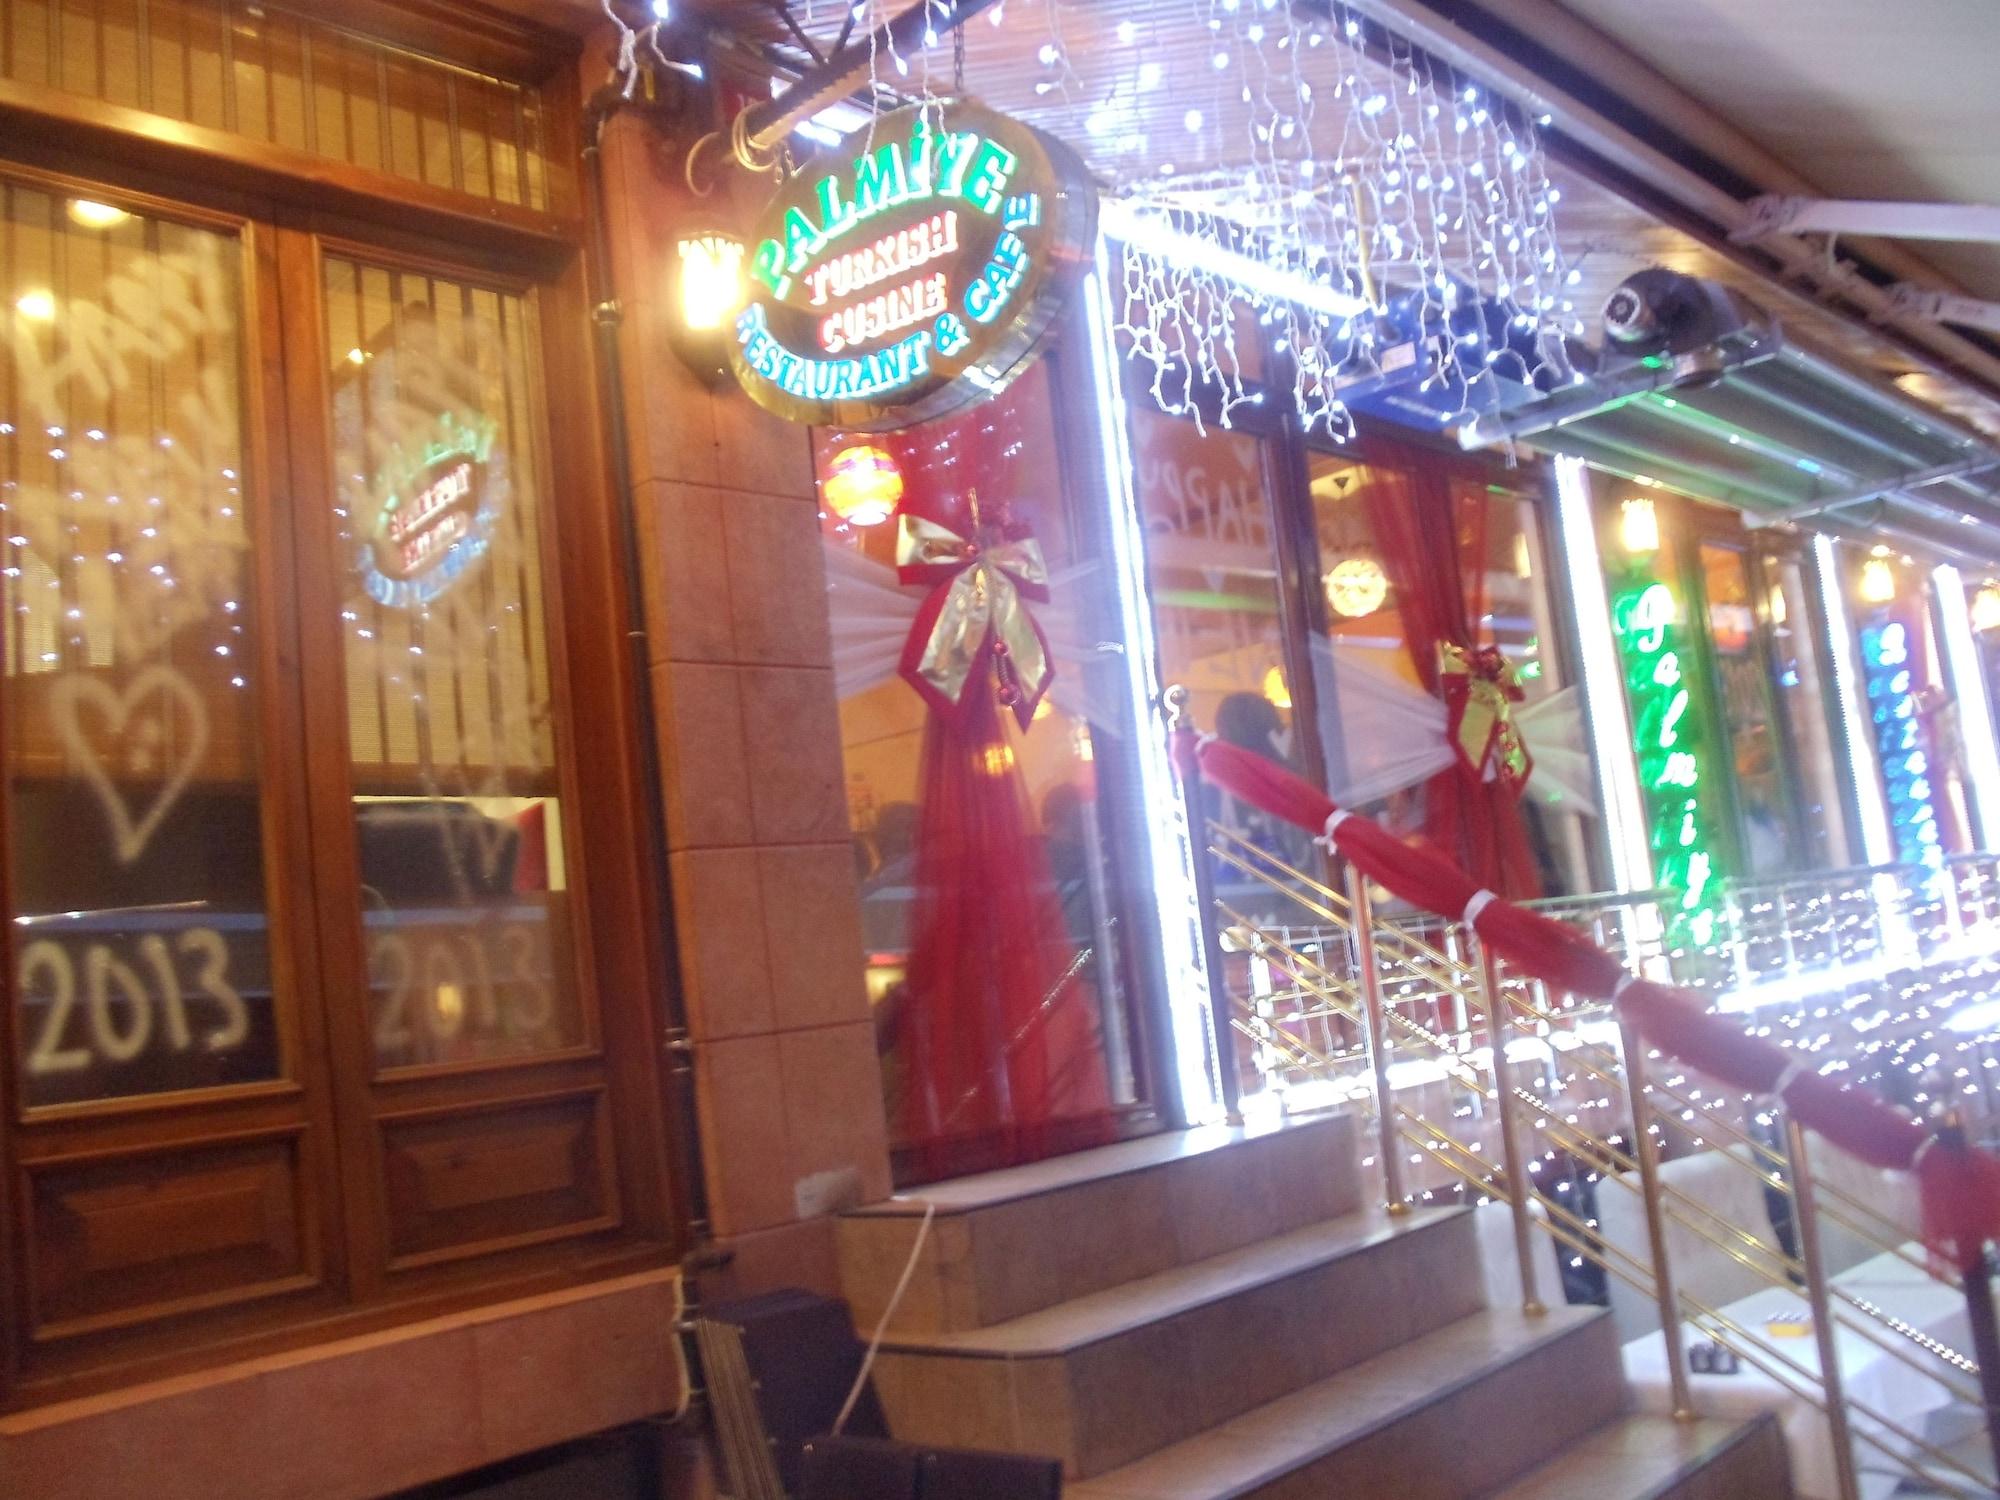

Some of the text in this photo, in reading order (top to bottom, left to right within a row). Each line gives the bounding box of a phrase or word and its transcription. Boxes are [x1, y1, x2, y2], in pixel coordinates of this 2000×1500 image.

[802, 209, 959, 306] TURKISH
[735, 301, 932, 400] RESTAURANT
[933, 312, 971, 357] &
[18, 928, 250, 1075] 2013
